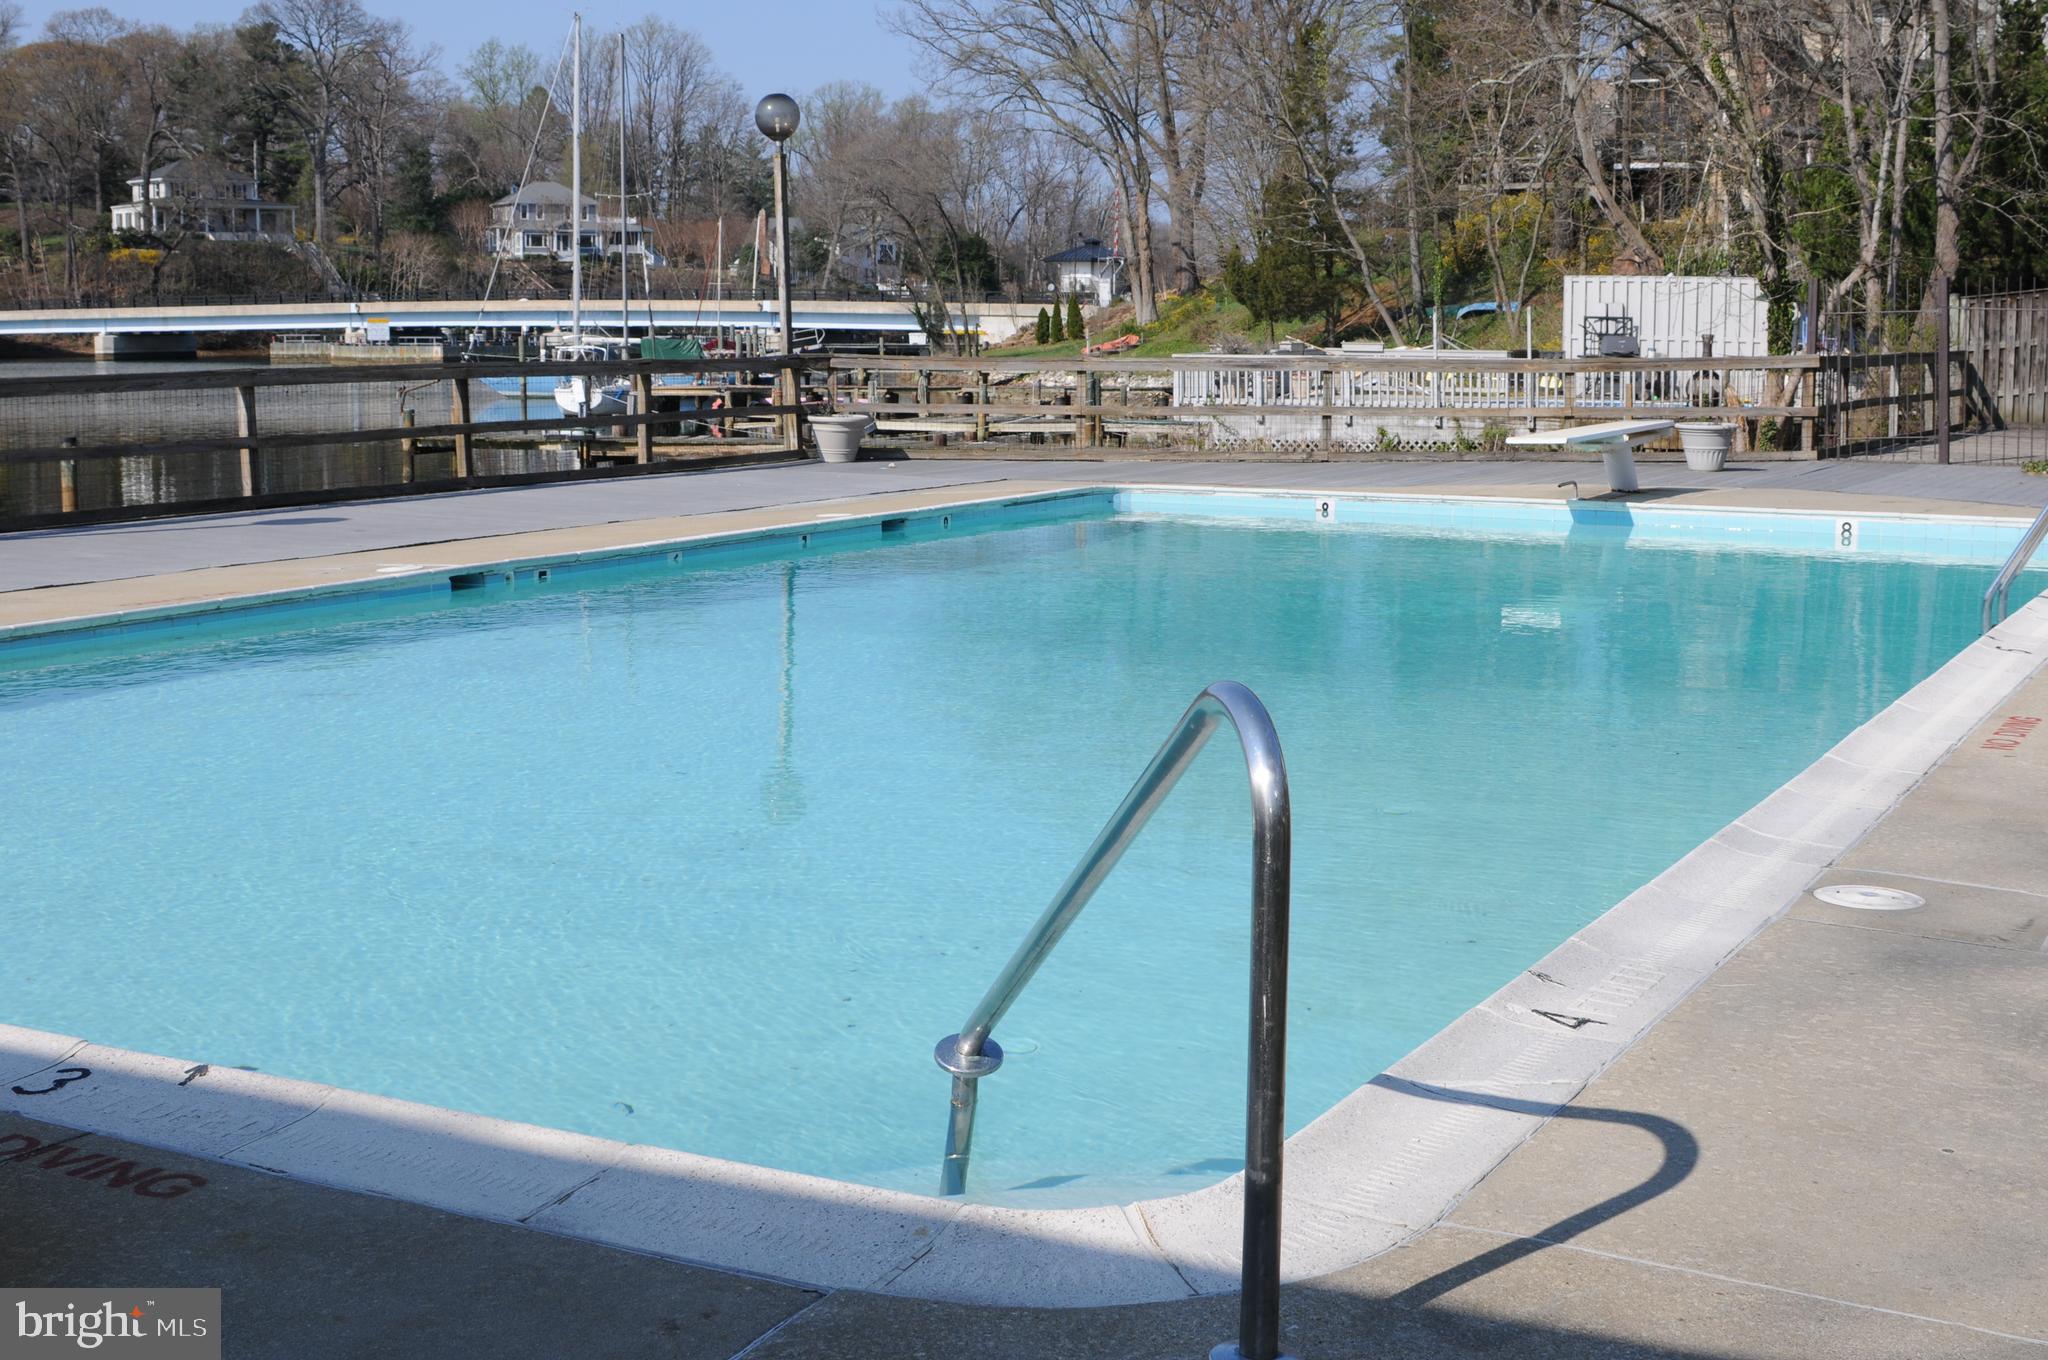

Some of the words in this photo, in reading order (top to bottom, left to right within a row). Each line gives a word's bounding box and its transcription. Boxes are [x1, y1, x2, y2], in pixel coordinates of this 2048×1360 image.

[1841, 521, 1852, 540] 8
[1531, 1009, 1608, 1030] 4
[11, 1067, 92, 1095] 3
